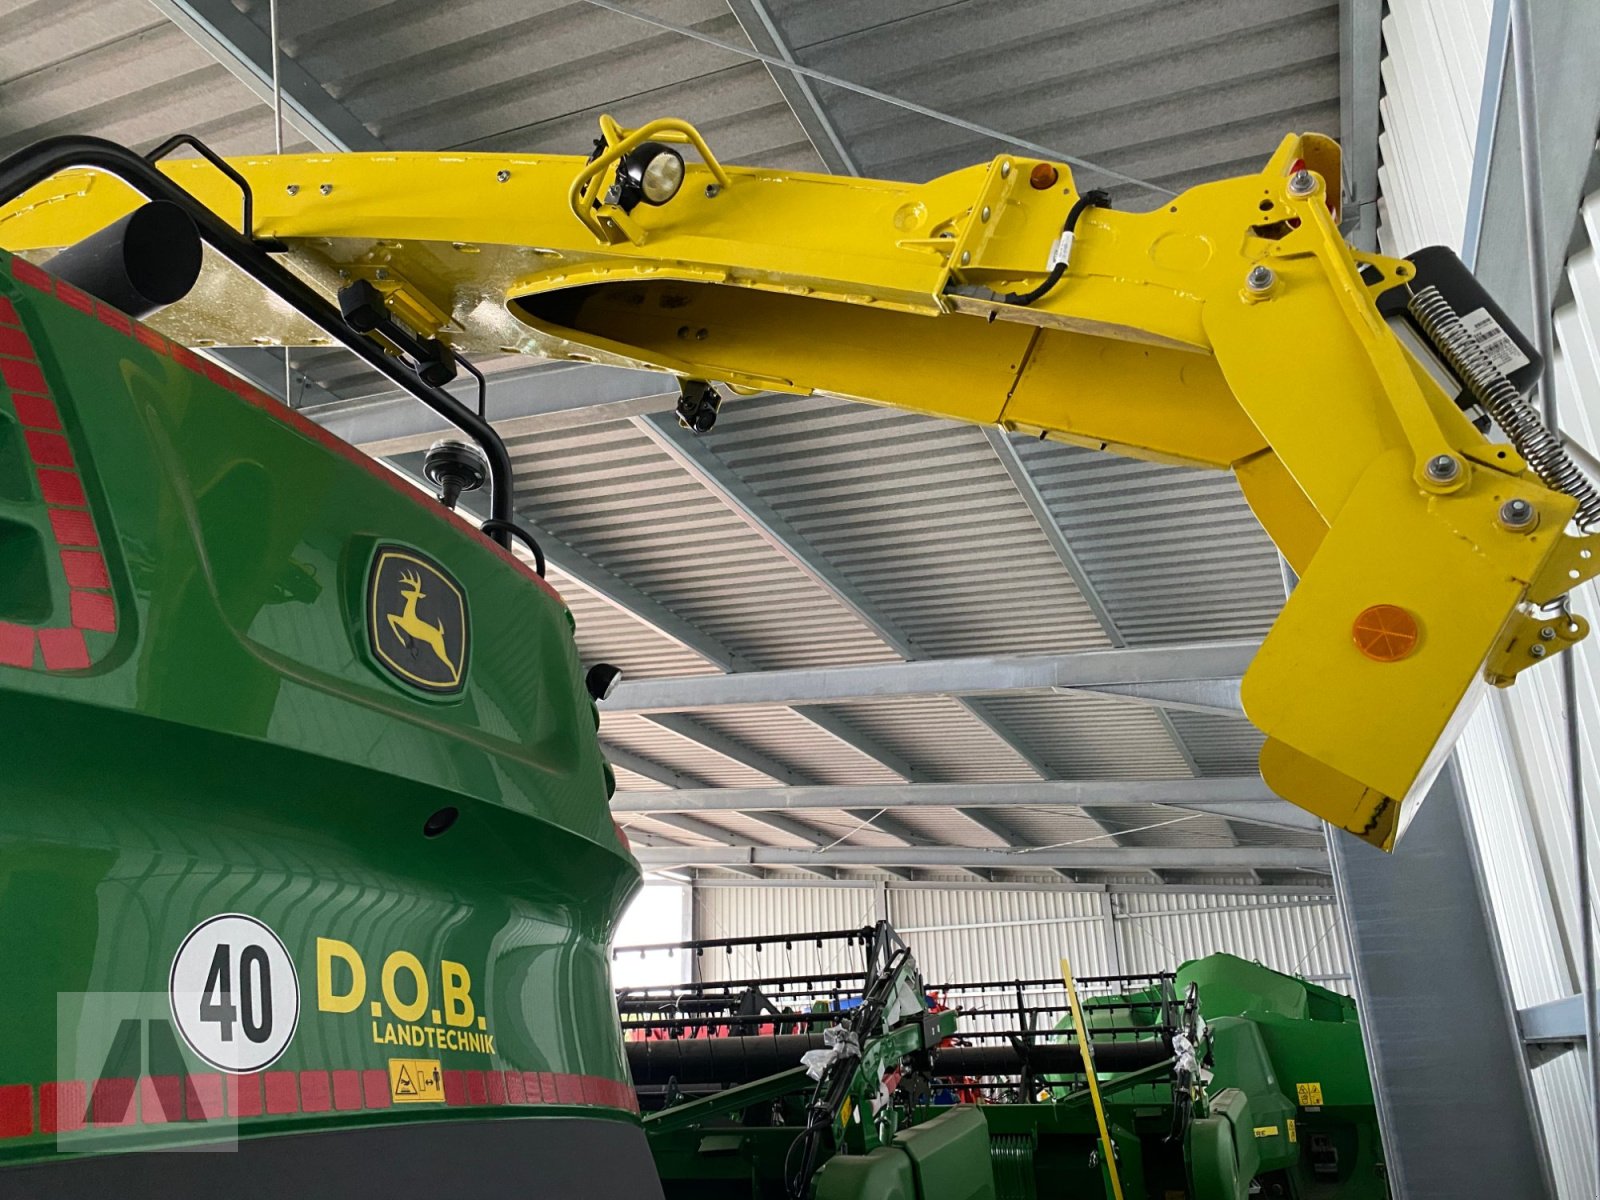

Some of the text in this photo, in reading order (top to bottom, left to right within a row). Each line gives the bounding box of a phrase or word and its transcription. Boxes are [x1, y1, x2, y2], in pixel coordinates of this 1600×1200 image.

[200, 943, 273, 1044] 40
[316, 936, 487, 1030] D.O.B.
[371, 1020, 496, 1055] LANDTECHNIK
